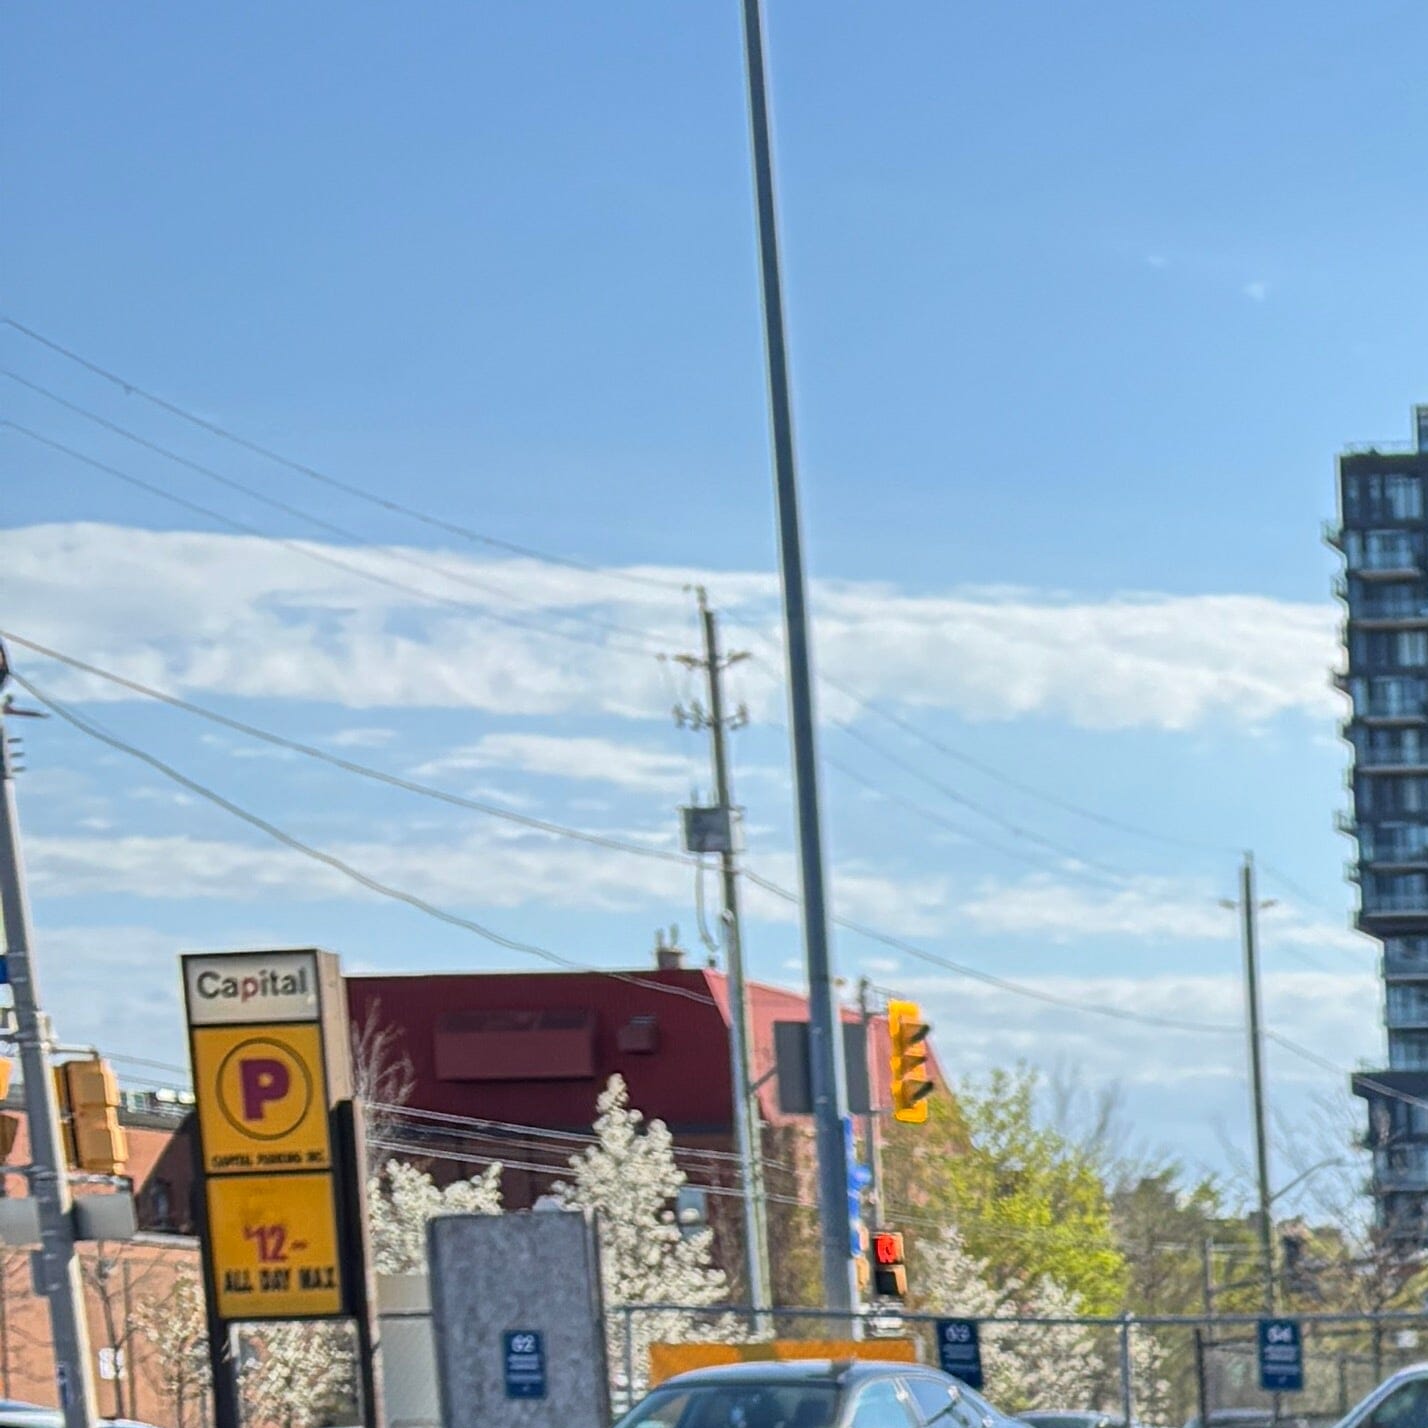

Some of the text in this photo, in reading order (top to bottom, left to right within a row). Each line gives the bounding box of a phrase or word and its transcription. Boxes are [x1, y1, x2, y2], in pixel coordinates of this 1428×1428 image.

[197, 968, 308, 1002] Capital
[239, 1058, 291, 1121] P
[224, 1266, 336, 1293] ALL DAY MAX
